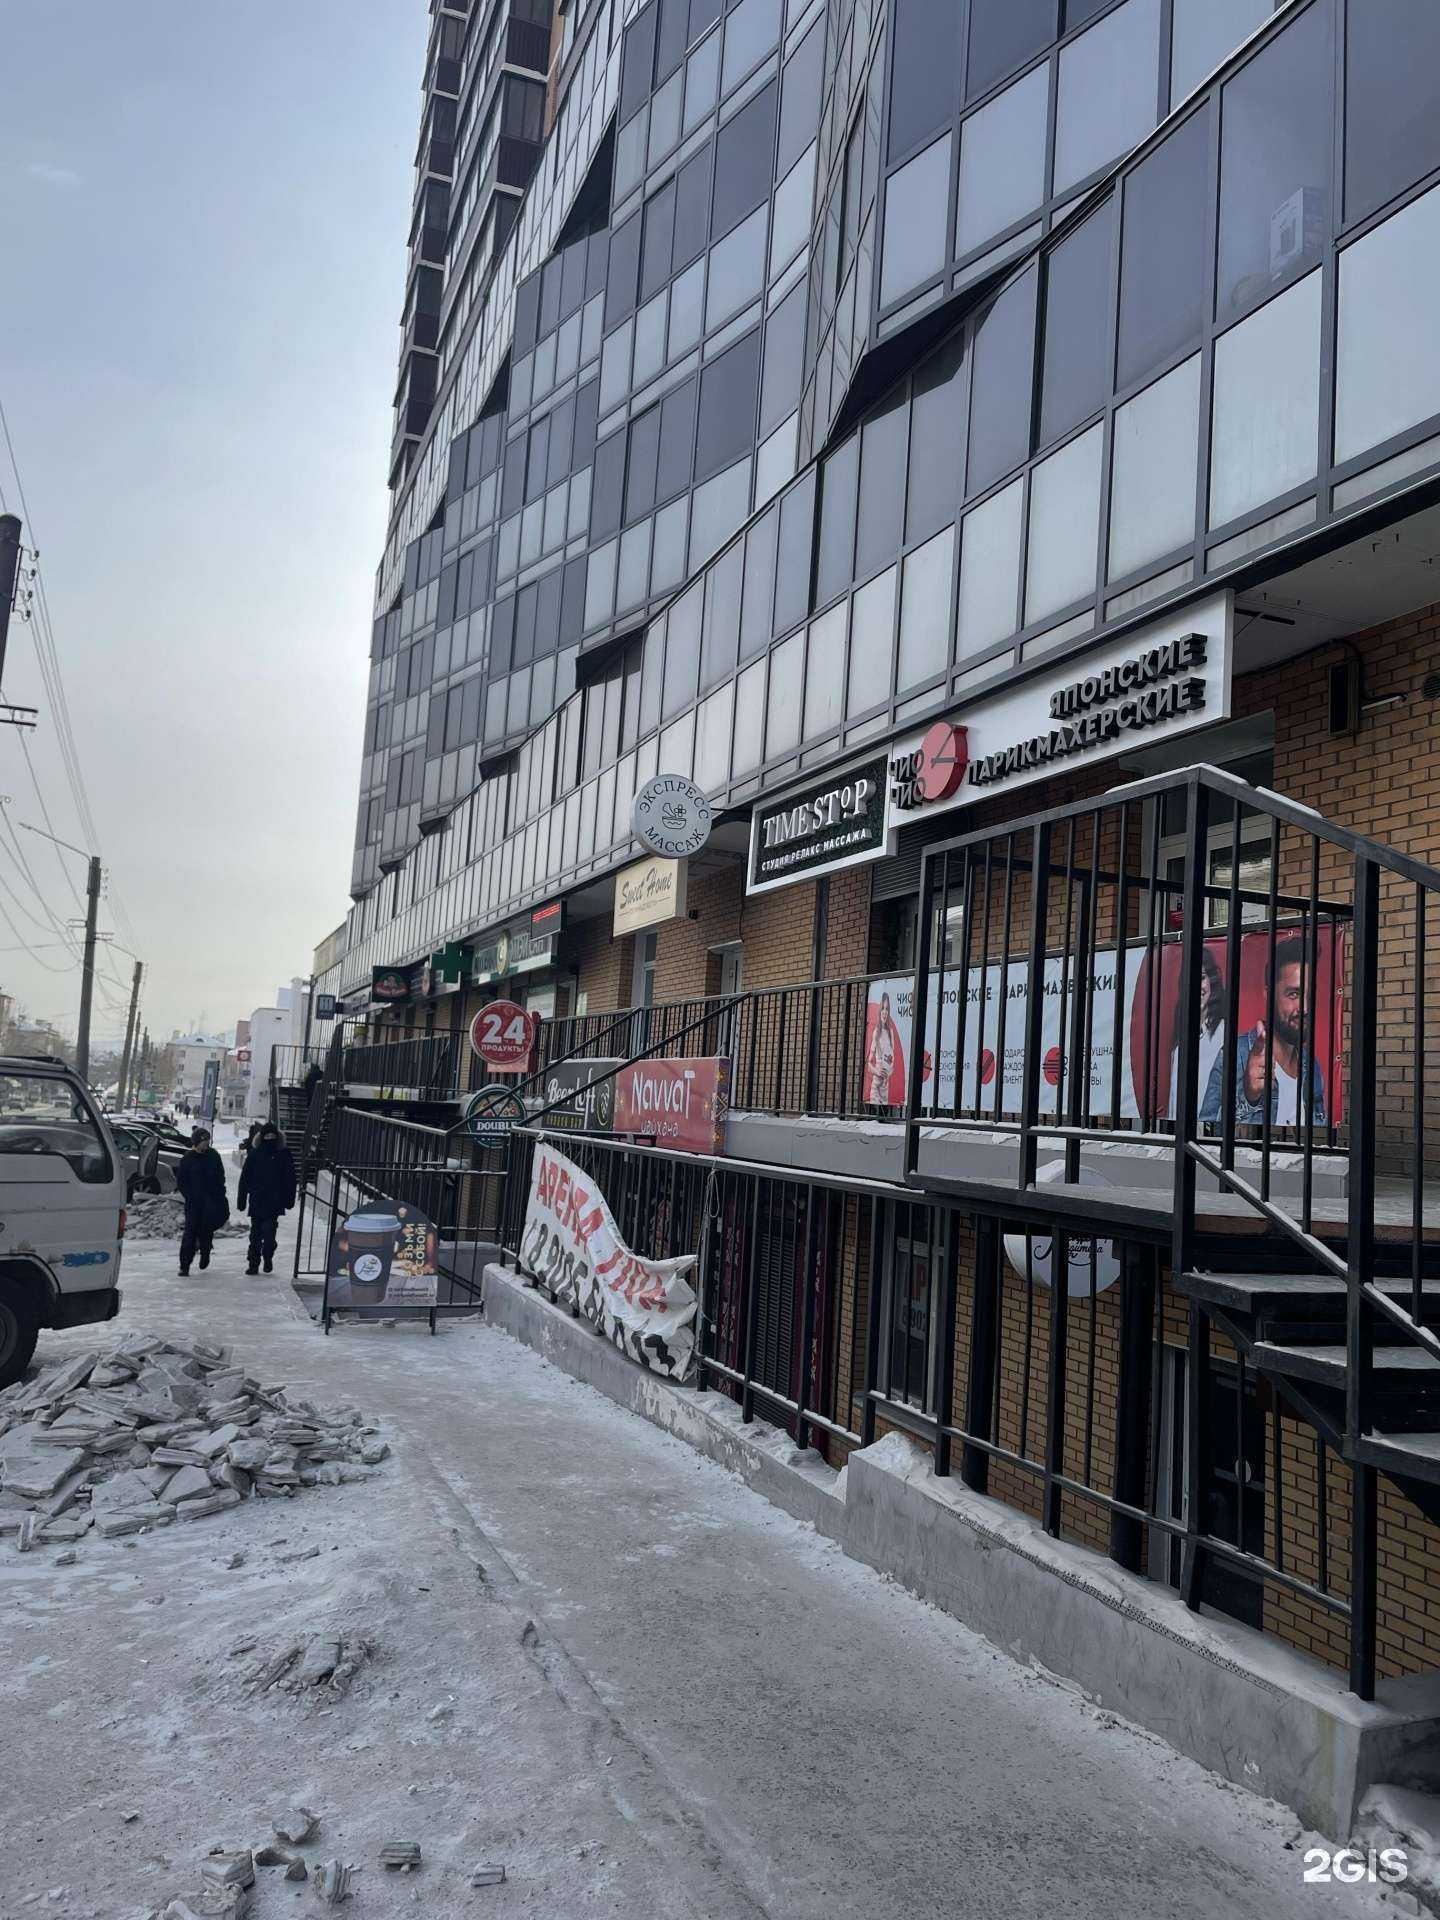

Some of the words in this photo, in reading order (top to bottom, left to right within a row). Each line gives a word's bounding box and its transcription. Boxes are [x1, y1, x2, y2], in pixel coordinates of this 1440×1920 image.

[1049, 633, 1206, 719] ЯПОНСКИЕ
[963, 678, 1205, 785] ПАРИКМАХЕРСКИЕ
[888, 749, 925, 782] ЧИО
[639, 780, 709, 820] ЭКСПРЕСС
[890, 777, 926, 809] ЧИО
[644, 825, 705, 853] МАССАЖ
[761, 855, 788, 871] СТУДИЯ
[791, 843, 820, 862] РЕЛАКС
[823, 828, 867, 852] МАССАЖА
[646, 867, 673, 897] Home
[481, 1013, 526, 1045] 24
[481, 1044, 525, 1052] ПРОДУКТЫ
